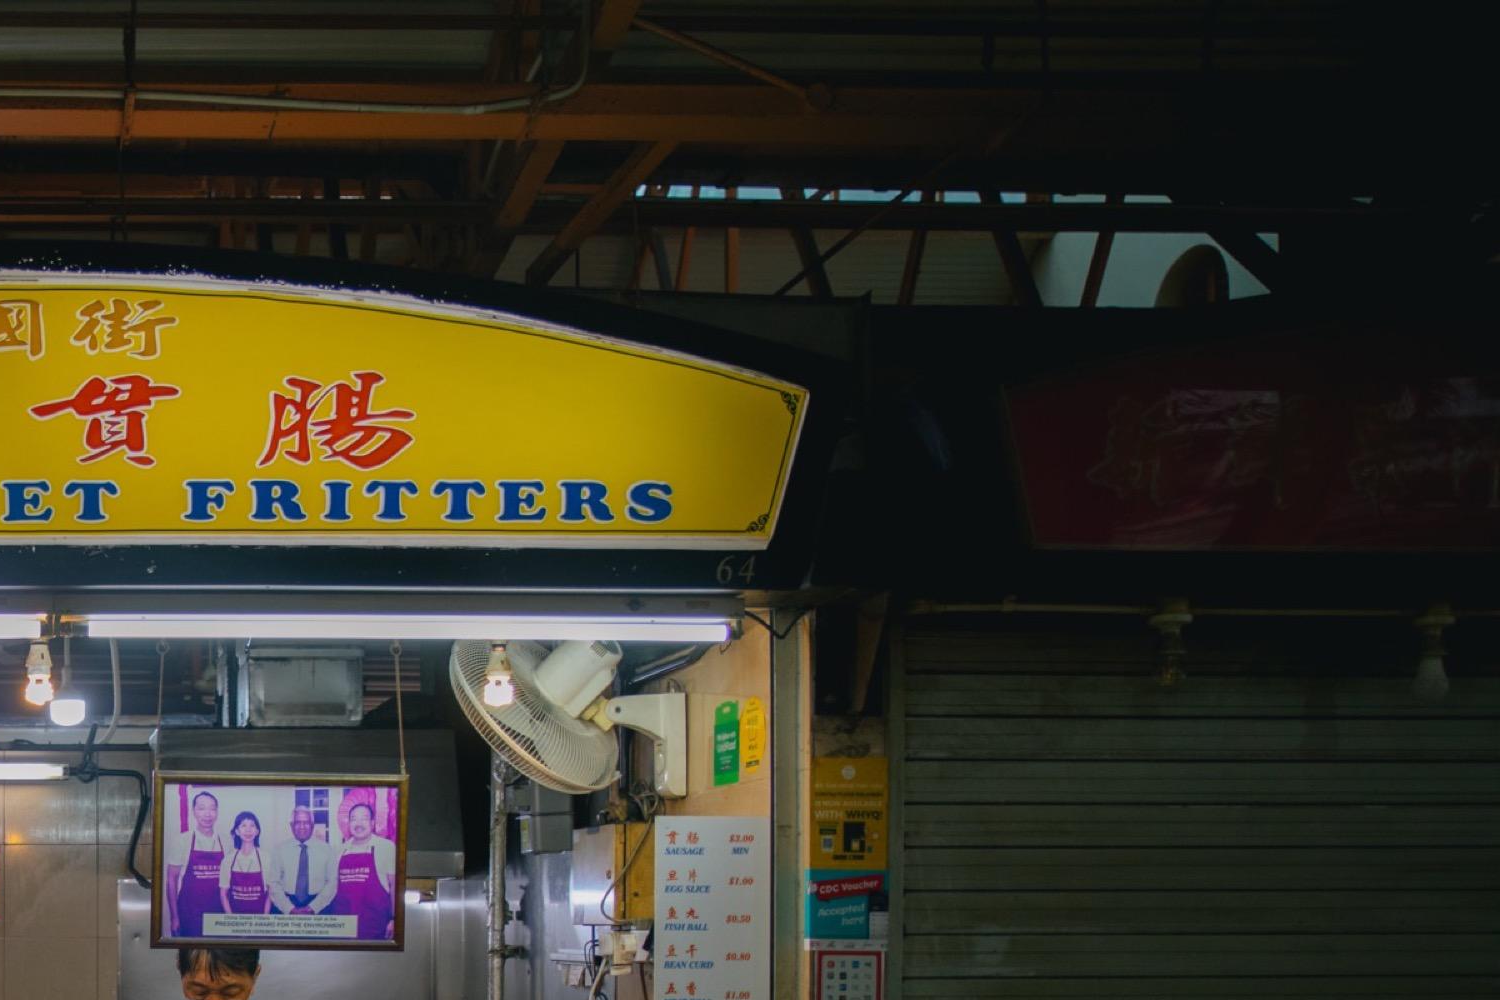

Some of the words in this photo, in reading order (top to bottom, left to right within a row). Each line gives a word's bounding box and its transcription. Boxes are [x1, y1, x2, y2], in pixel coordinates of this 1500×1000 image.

[182, 479, 674, 523] FRITTERS
[715, 555, 756, 585] 64
[728, 877, 753, 885] $1.00
[820, 884, 839, 895] CDC
[840, 880, 879, 891] Voucher
[818, 903, 866, 918] Accepted
[664, 923, 686, 931] FISH
[687, 923, 709, 931] BALL
[664, 961, 687, 969] BEAN
[689, 961, 714, 969] CURD
